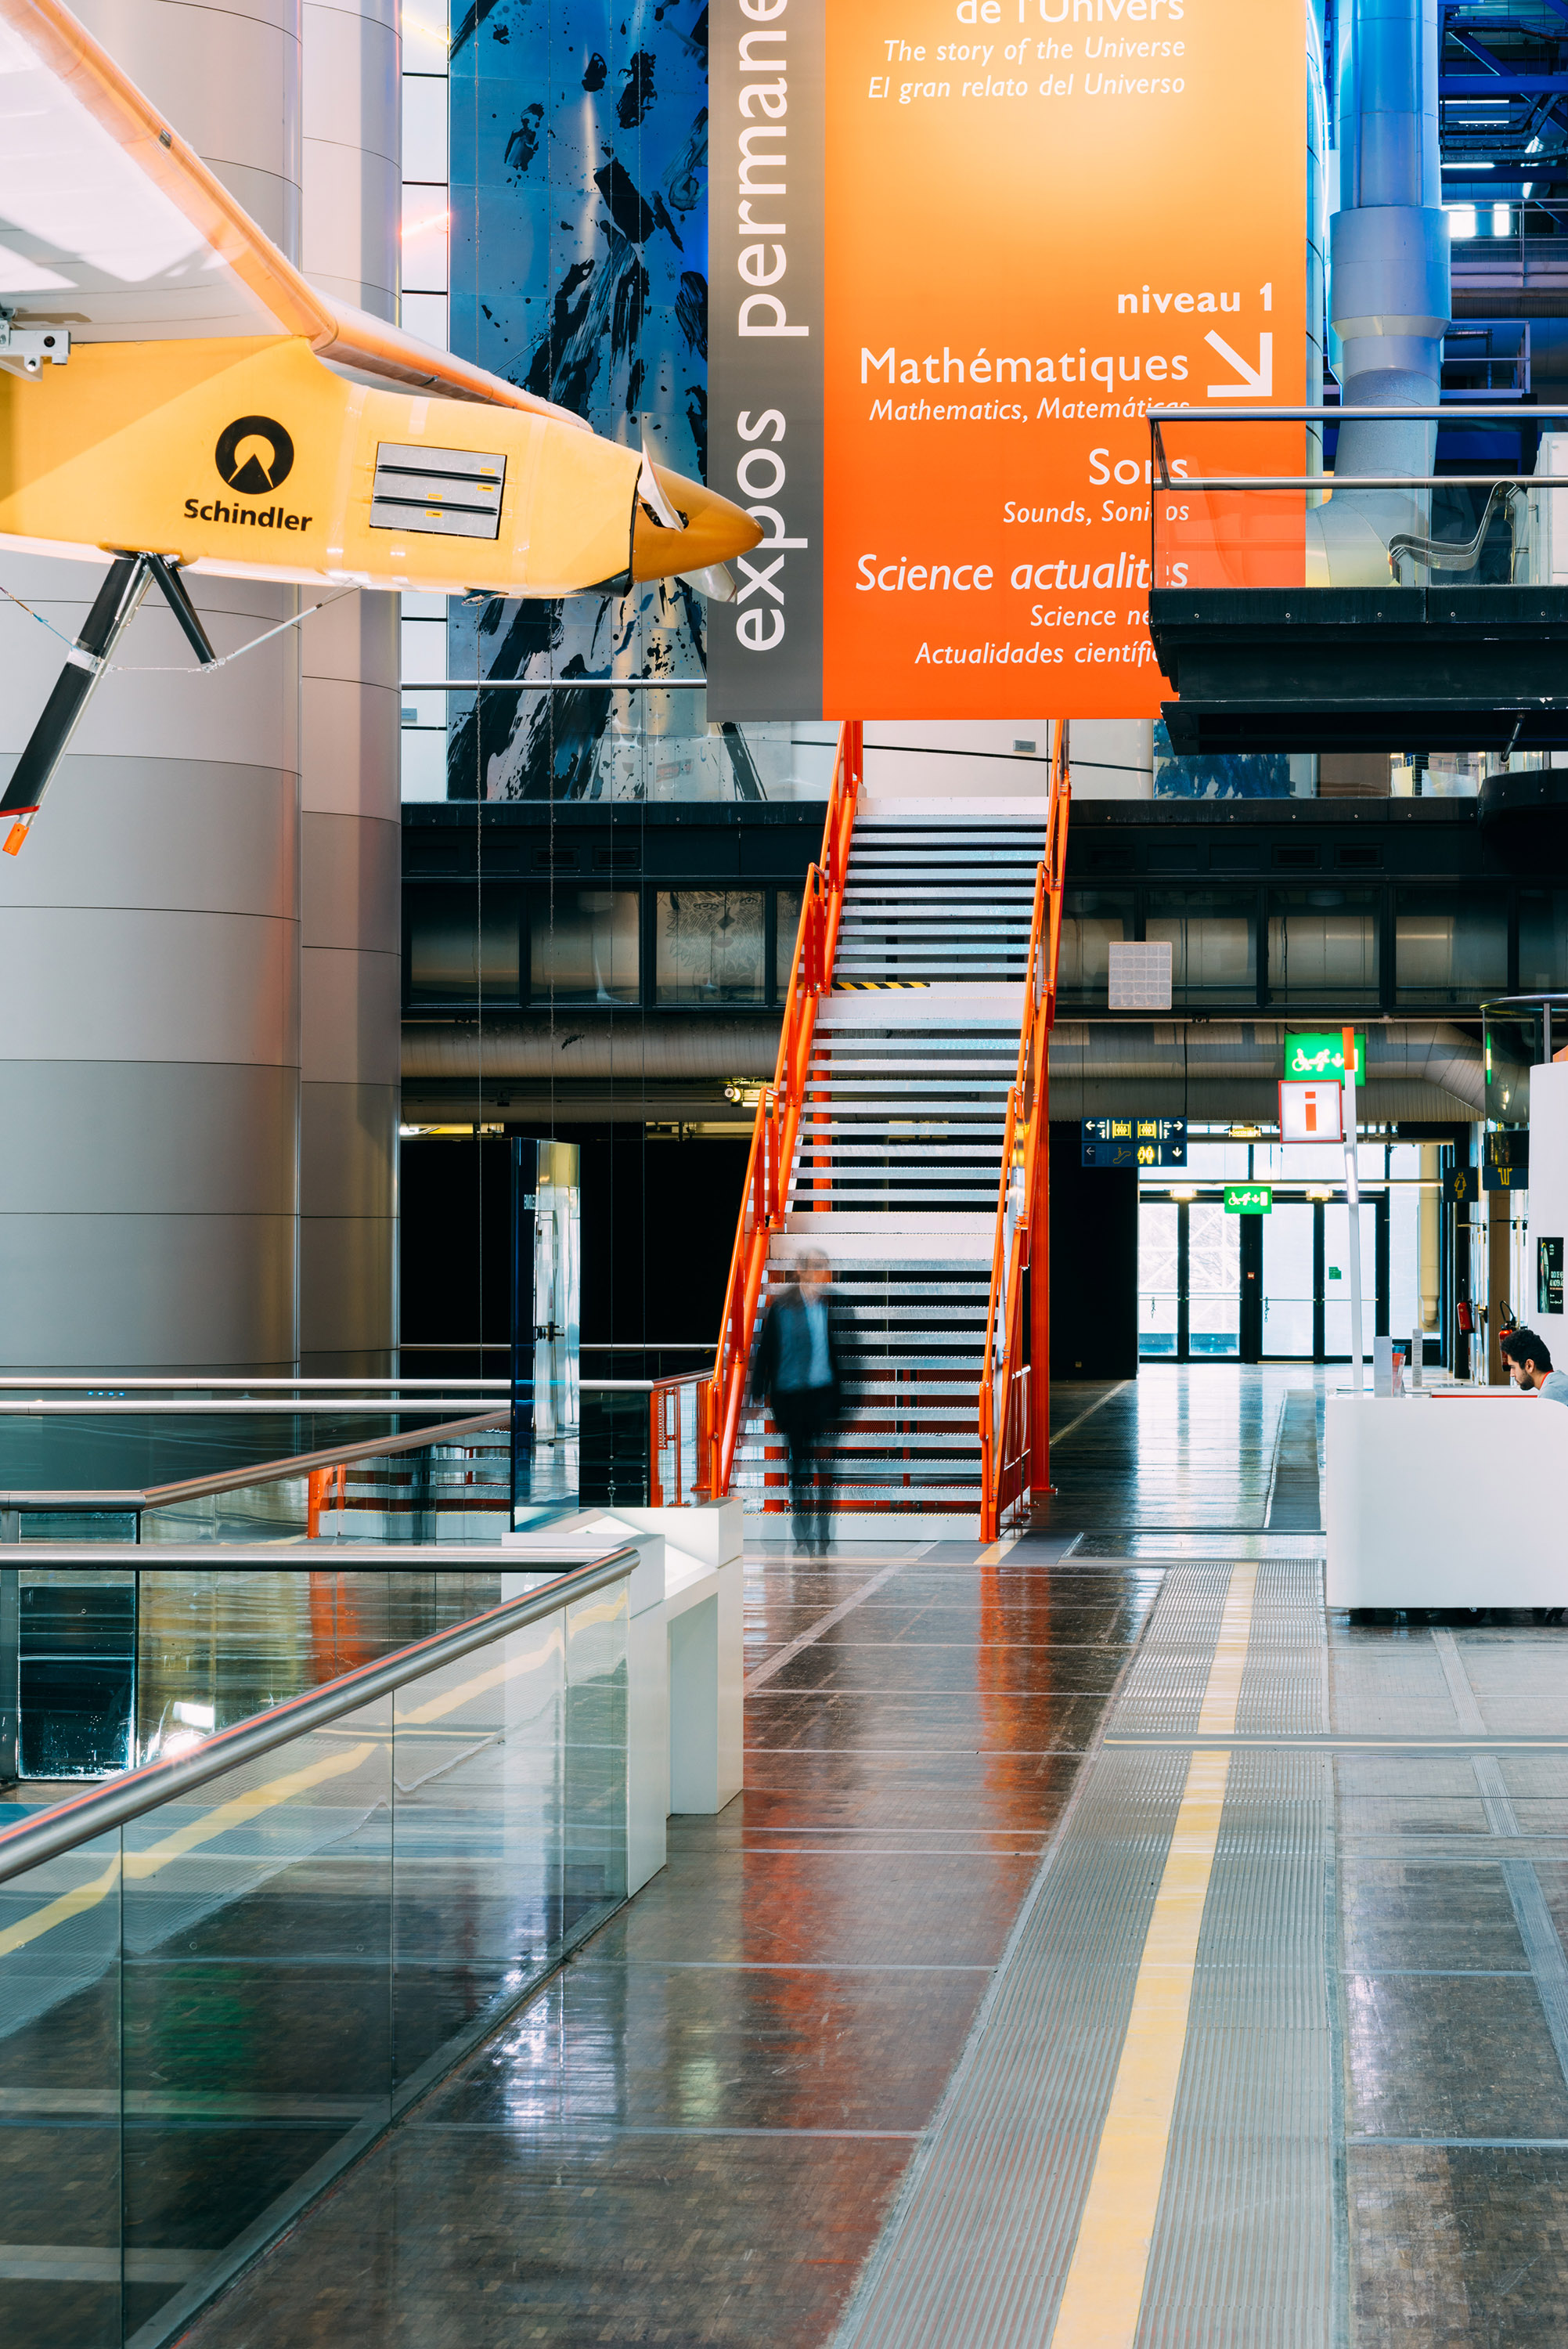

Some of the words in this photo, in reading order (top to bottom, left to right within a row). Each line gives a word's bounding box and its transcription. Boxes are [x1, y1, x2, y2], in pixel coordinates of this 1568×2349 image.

[956, 0, 1001, 23] de
[1018, 0, 1184, 23] lUnivers
[885, 40, 925, 62] The
[936, 43, 995, 67] story
[1004, 38, 1032, 65] of
[1037, 38, 1073, 60] the
[1084, 37, 1185, 59] Universe
[868, 77, 889, 99] El
[899, 81, 950, 104] gran
[961, 75, 1028, 97] relato
[1040, 74, 1074, 96] del
[1084, 73, 1185, 95] Universo
[1117, 285, 1241, 314] niveau
[1259, 283, 1272, 311] 1
[861, 347, 1189, 393] Mathématiques
[869, 399, 1029, 424] Mathematics,
[184, 497, 312, 532] Schindler
[1003, 500, 1092, 526] Sounds,
[1101, 500, 1190, 522] Sonios
[737, 409, 809, 651] expos
[856, 554, 994, 592] Science
[1030, 604, 1116, 627] Science
[914, 641, 1064, 665] Actualidades
